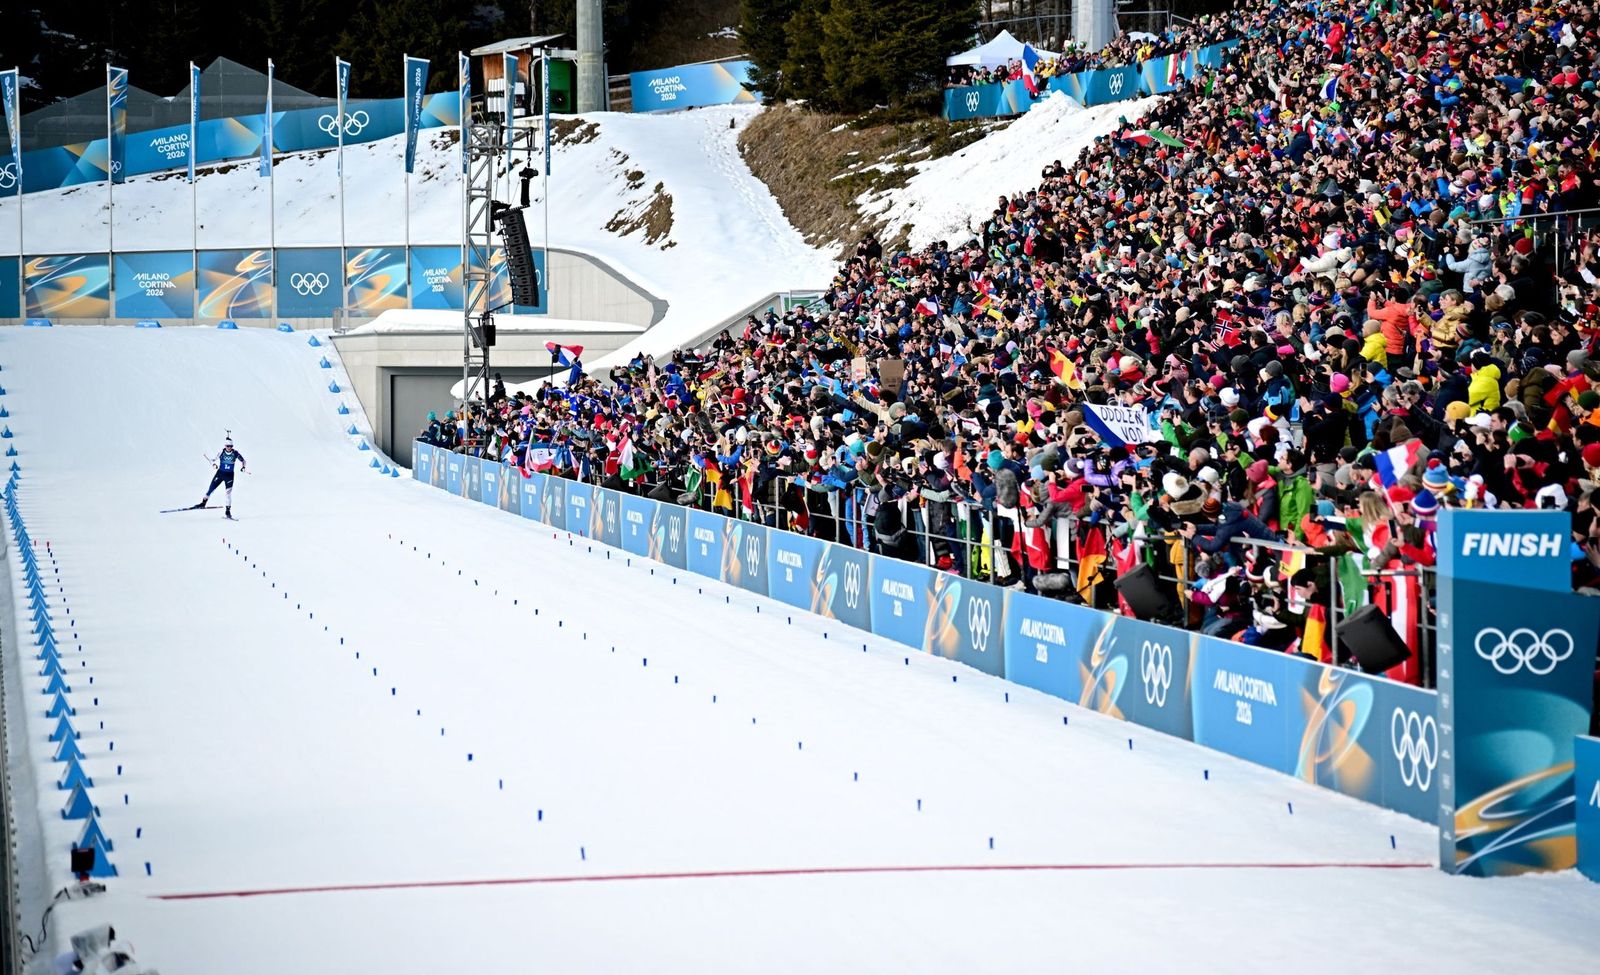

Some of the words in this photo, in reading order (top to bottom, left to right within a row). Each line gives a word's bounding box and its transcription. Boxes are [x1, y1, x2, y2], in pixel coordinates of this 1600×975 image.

[648, 76, 681, 87] MILANO
[654, 83, 687, 94] CORTINA
[660, 92, 677, 101] 2026
[150, 133, 188, 147] MILANO
[157, 141, 191, 153] CORTIN
[166, 150, 186, 160] 2026
[132, 273, 170, 281] MILANO
[423, 268, 448, 277] MILANO
[139, 280, 177, 289] CORTINA
[427, 275, 453, 284] CORTINA
[145, 288, 164, 297] 2026
[1462, 532, 1562, 557] FINISH
[1020, 617, 1043, 641] MILANO
[1042, 621, 1066, 647] CORTINA
[1213, 668, 1244, 697] MILANO
[1244, 675, 1278, 706] CORTINA
[1236, 700, 1252, 725] 2026
